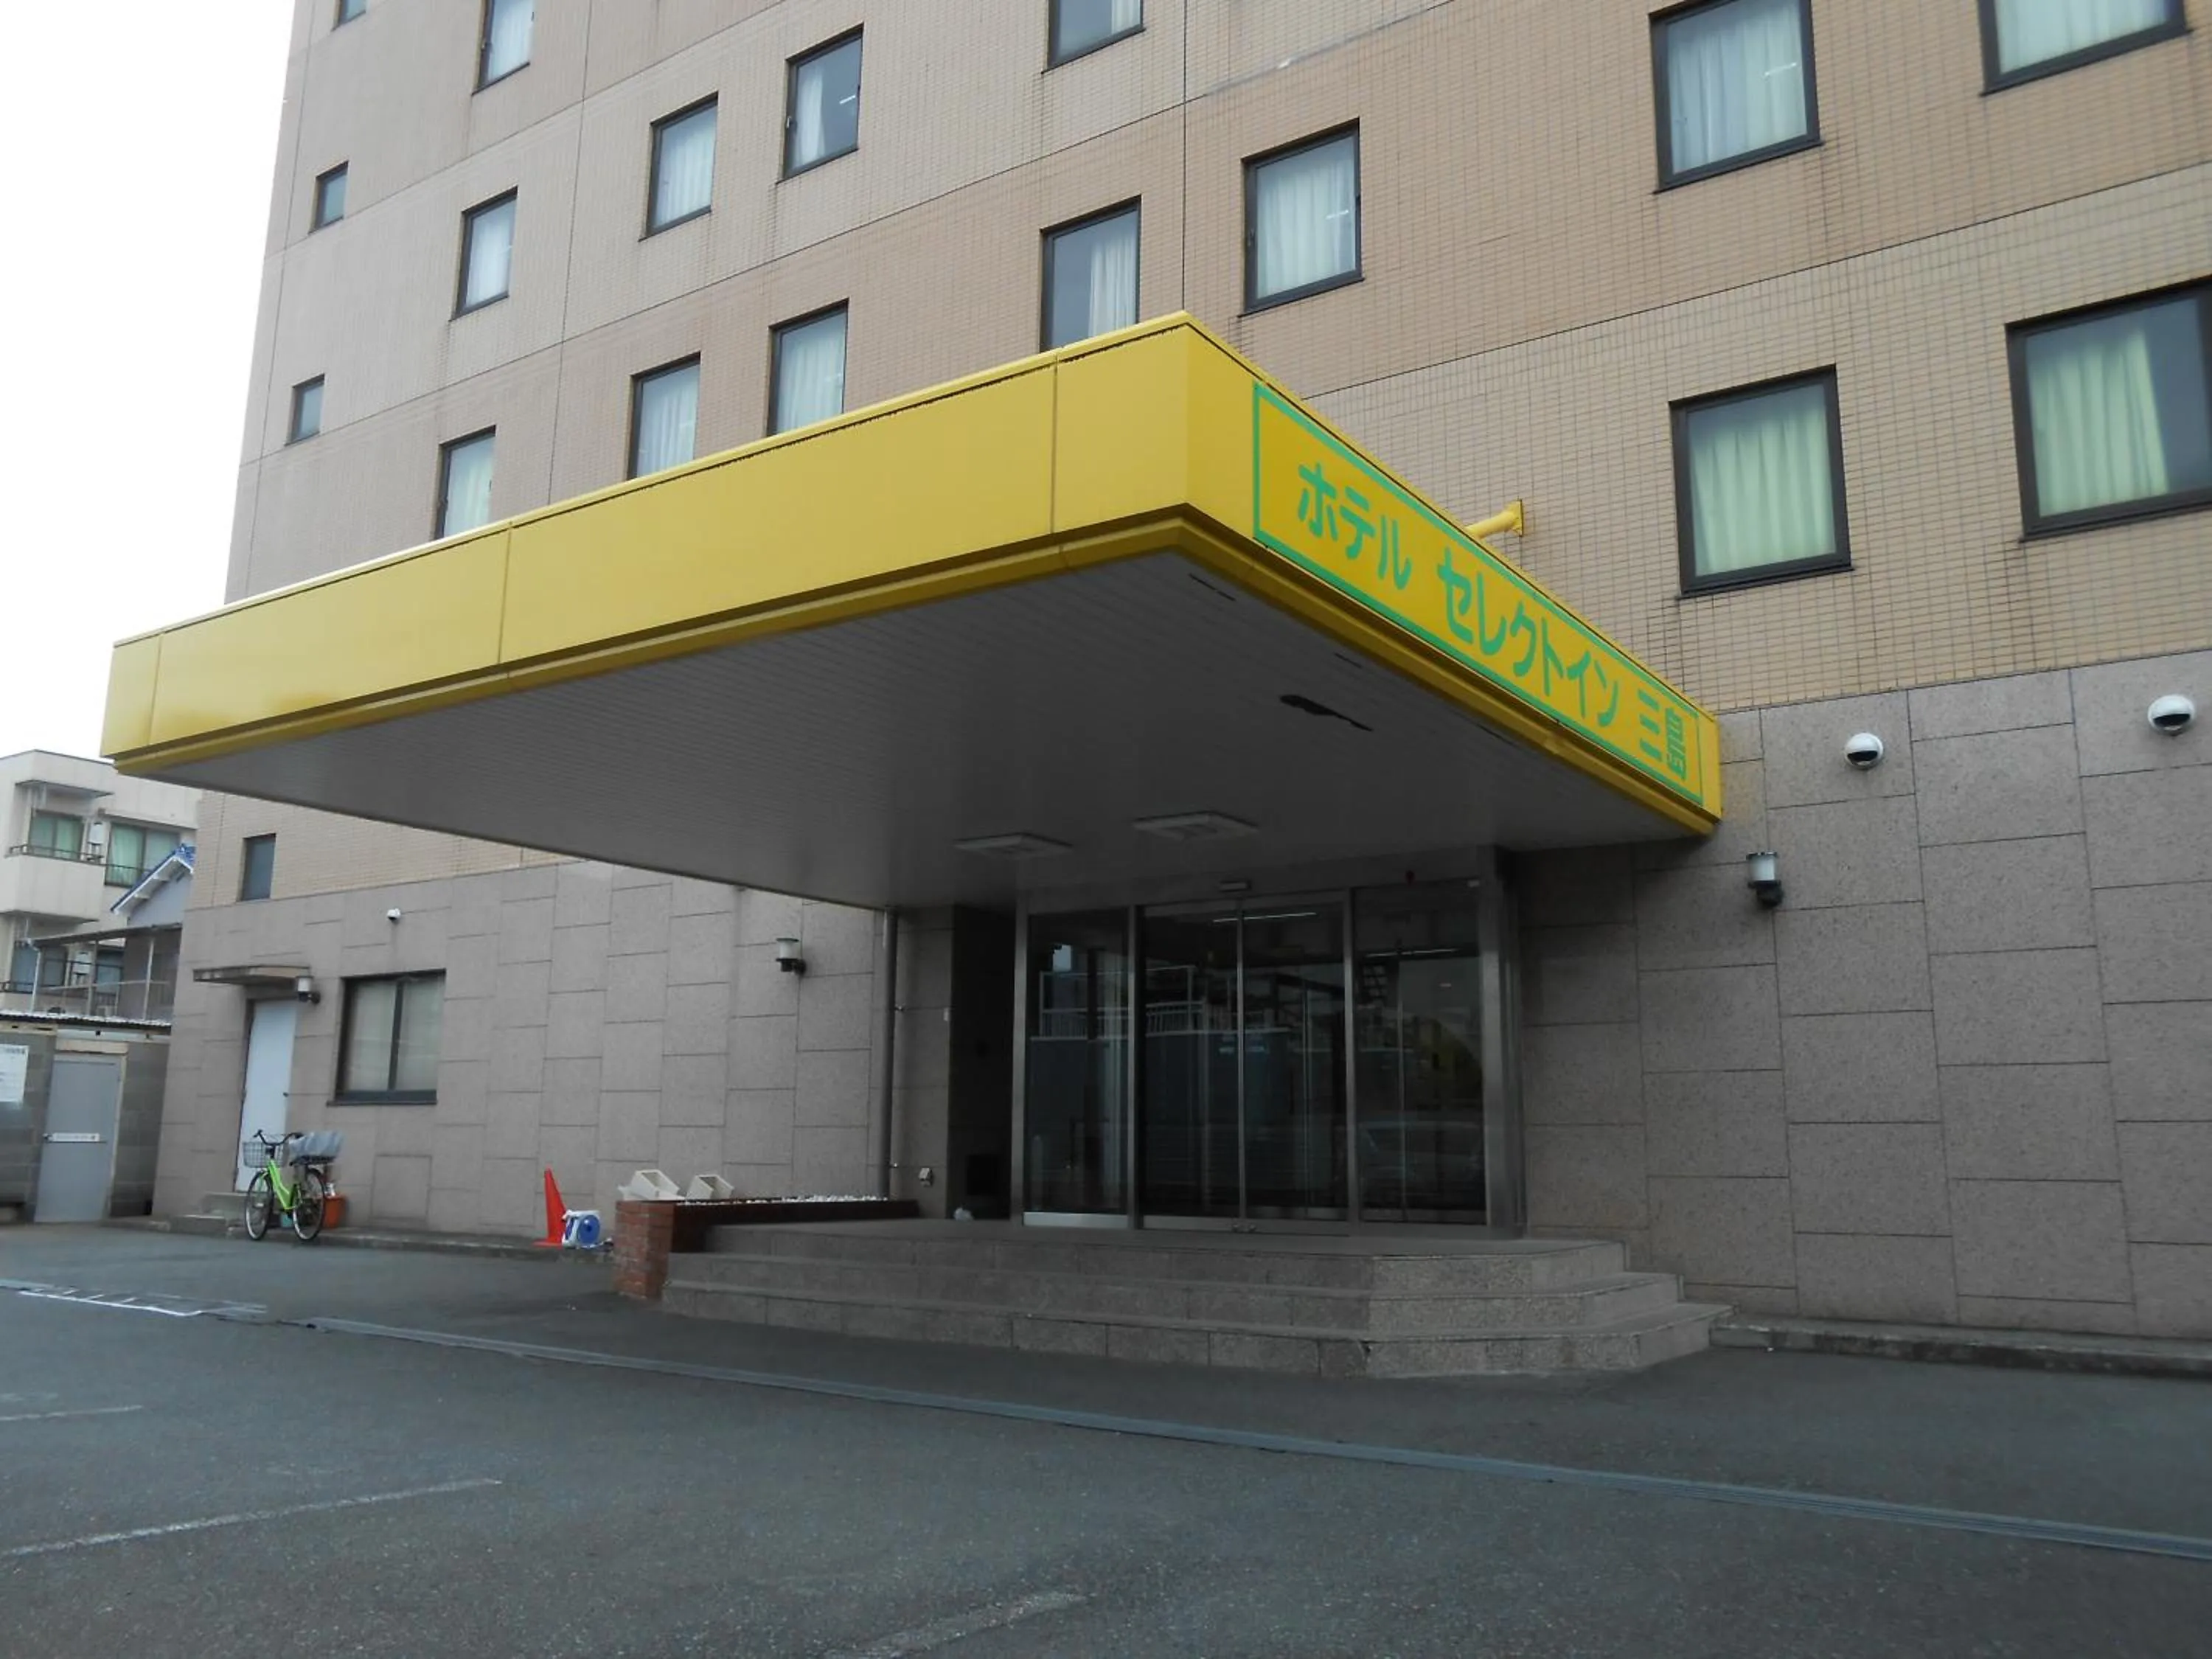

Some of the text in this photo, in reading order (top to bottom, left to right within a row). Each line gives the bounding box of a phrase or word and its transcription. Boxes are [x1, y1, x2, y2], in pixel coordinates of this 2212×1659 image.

[1298, 462, 1412, 590] ホテル
[1438, 548, 1618, 727] セレクトイン
